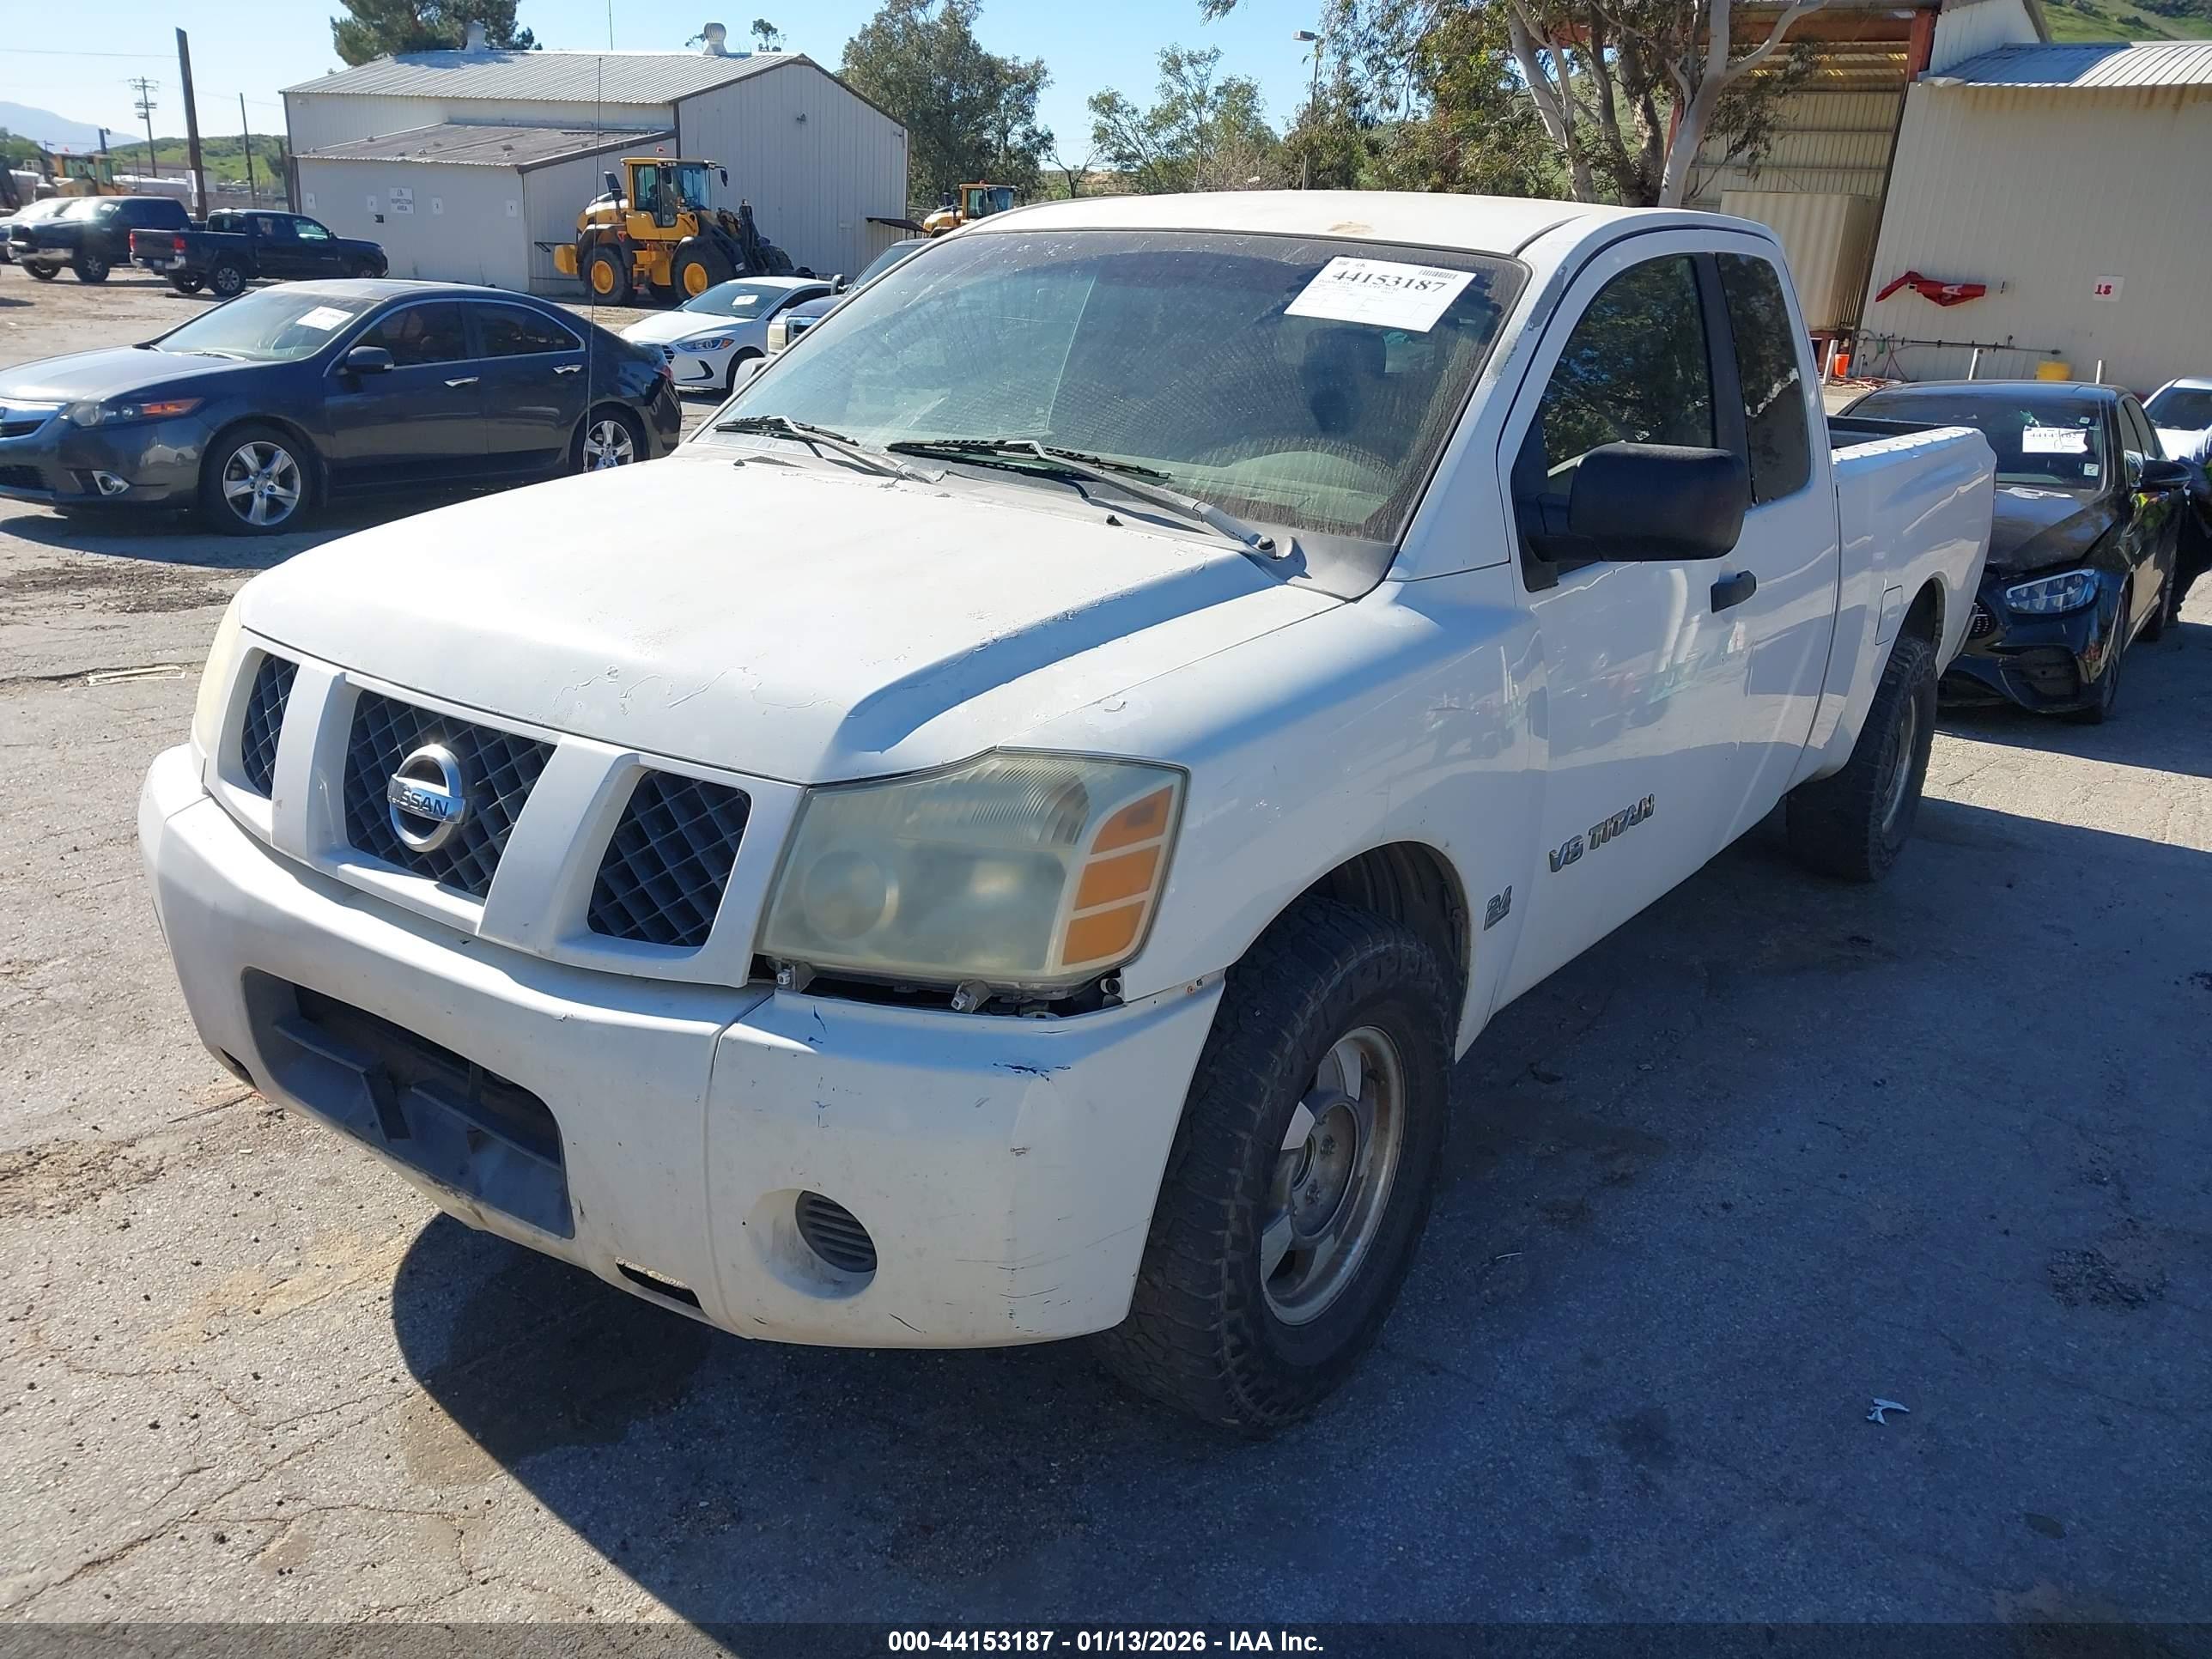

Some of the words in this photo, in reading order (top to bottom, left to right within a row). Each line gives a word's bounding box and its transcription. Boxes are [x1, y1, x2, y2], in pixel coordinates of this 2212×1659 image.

[1332, 270, 1449, 293] 44153187
[2094, 284, 2112, 295] 18
[391, 783, 449, 817] SSAN
[1589, 793, 1656, 850] TITAN
